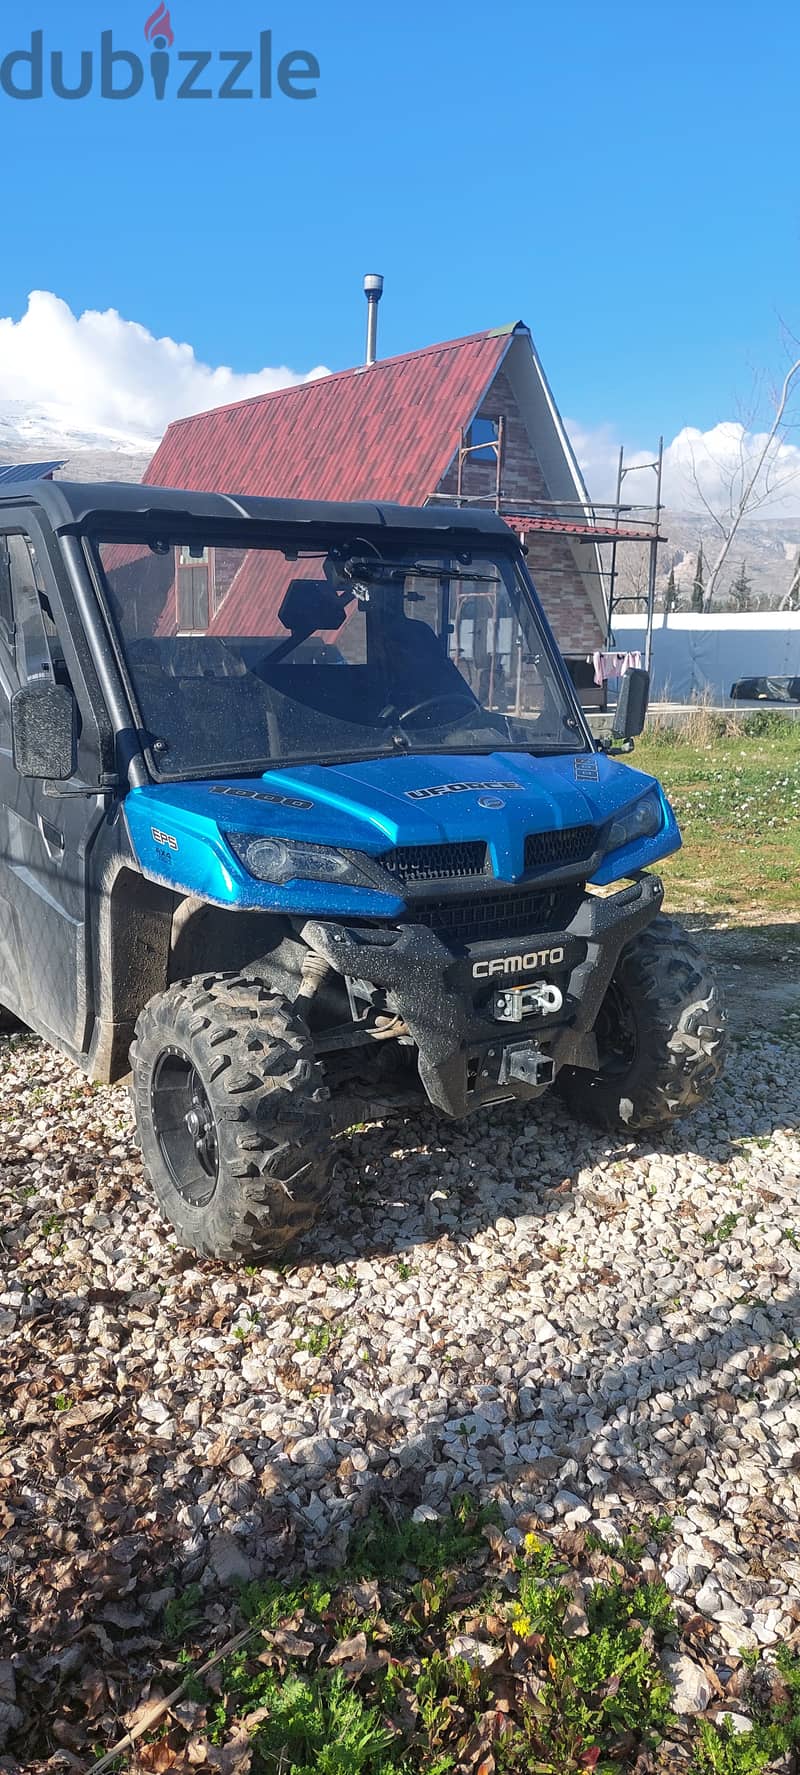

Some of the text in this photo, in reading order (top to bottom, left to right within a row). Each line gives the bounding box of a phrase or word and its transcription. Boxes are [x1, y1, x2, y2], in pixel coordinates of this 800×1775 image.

[208, 785, 315, 810] 1000
[404, 781, 525, 800] UFORCE
[151, 826, 179, 851] EPS
[472, 947, 564, 979] CFMOTO
